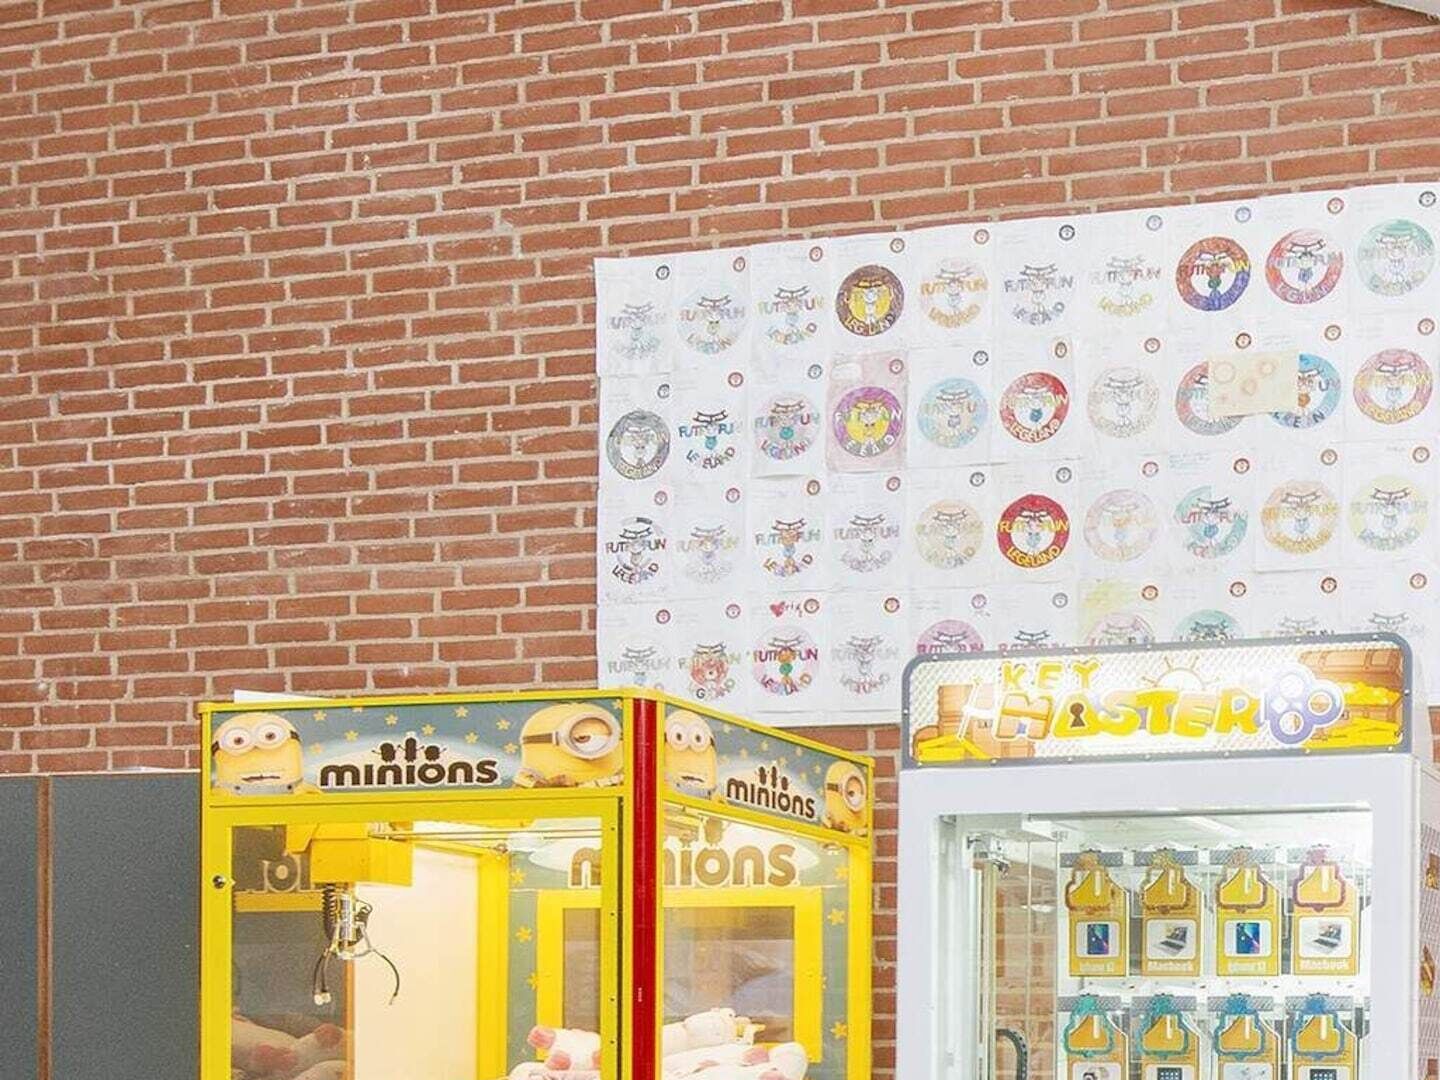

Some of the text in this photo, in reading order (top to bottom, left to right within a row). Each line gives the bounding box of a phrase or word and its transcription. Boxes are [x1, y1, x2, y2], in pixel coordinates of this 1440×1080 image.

[1002, 661, 1099, 689] KEY
[995, 687, 1261, 740] MASTER
[320, 758, 498, 787] minions
[726, 773, 816, 820] minions
